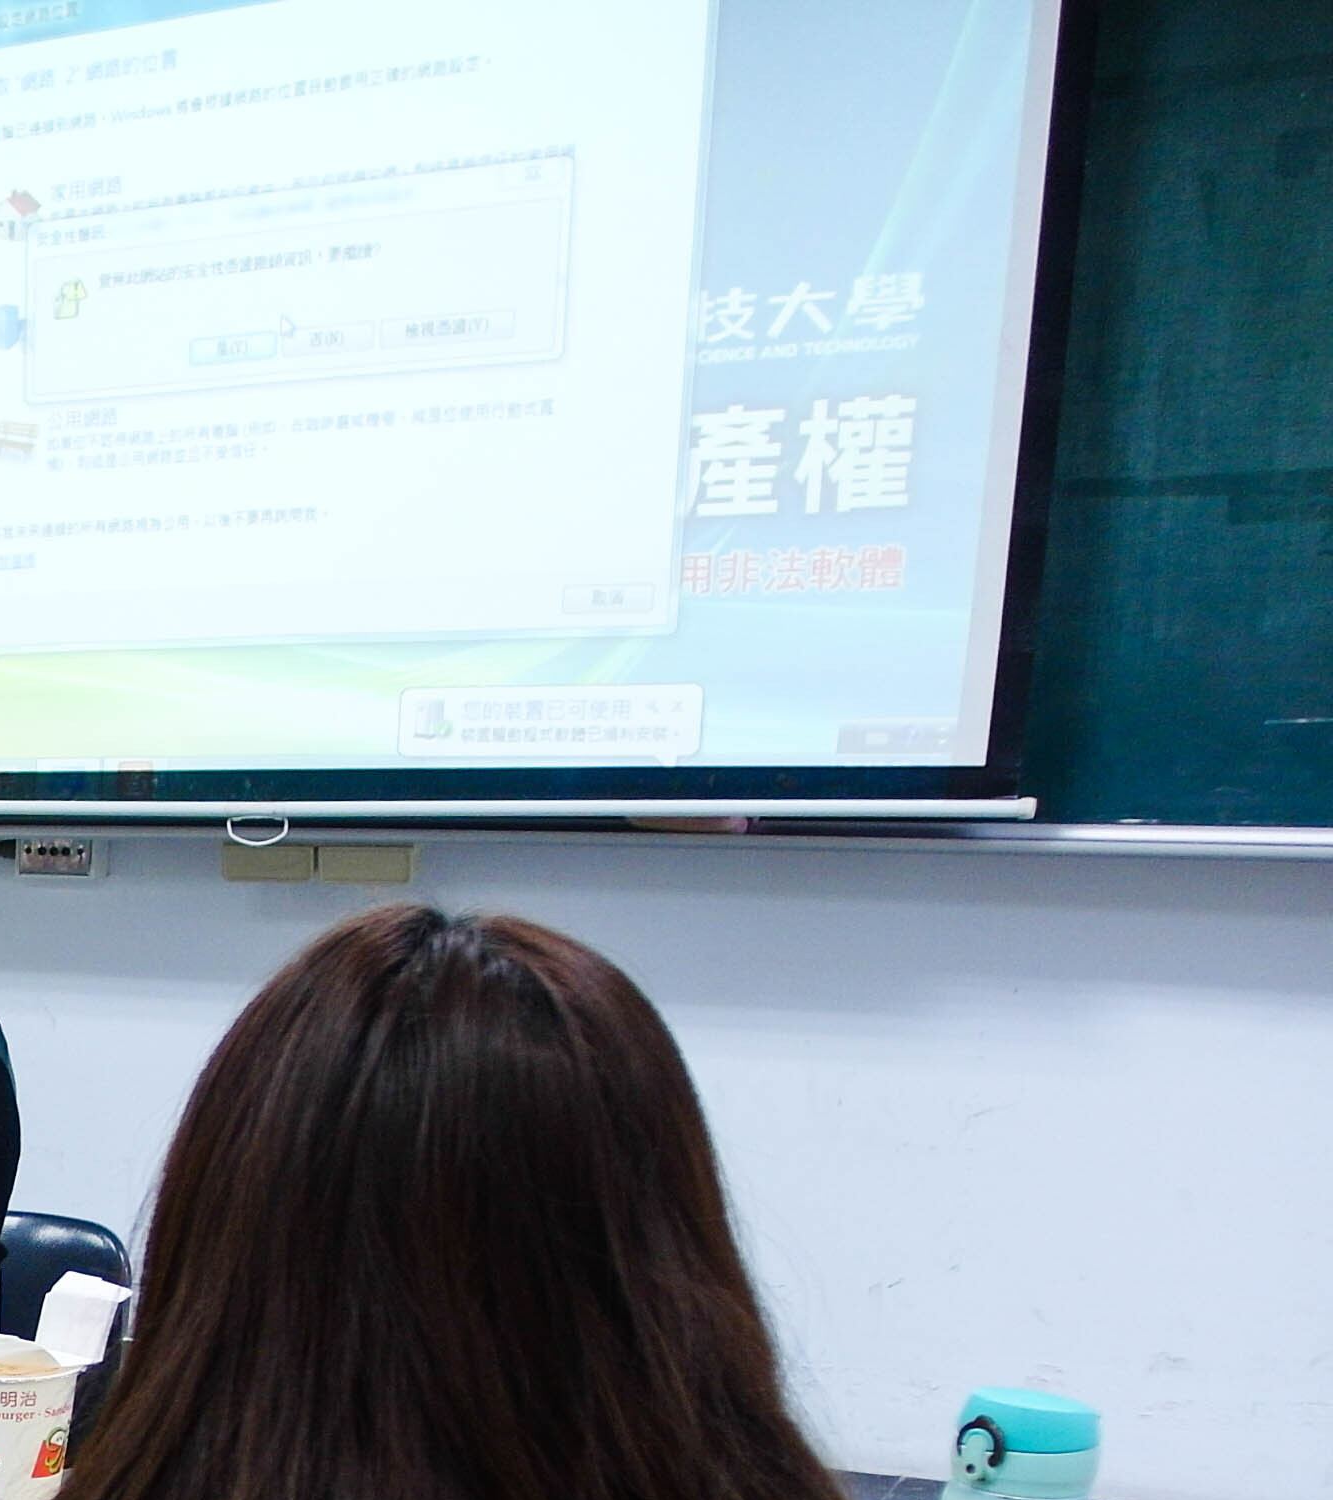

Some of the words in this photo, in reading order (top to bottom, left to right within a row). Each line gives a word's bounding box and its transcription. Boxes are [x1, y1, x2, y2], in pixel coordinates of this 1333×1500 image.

[698, 271, 925, 344] 技大學
[759, 342, 797, 359] AND
[804, 333, 921, 356] TECHNOLOGY
[687, 393, 918, 518] 產權
[680, 543, 907, 595] 用非法軟體
